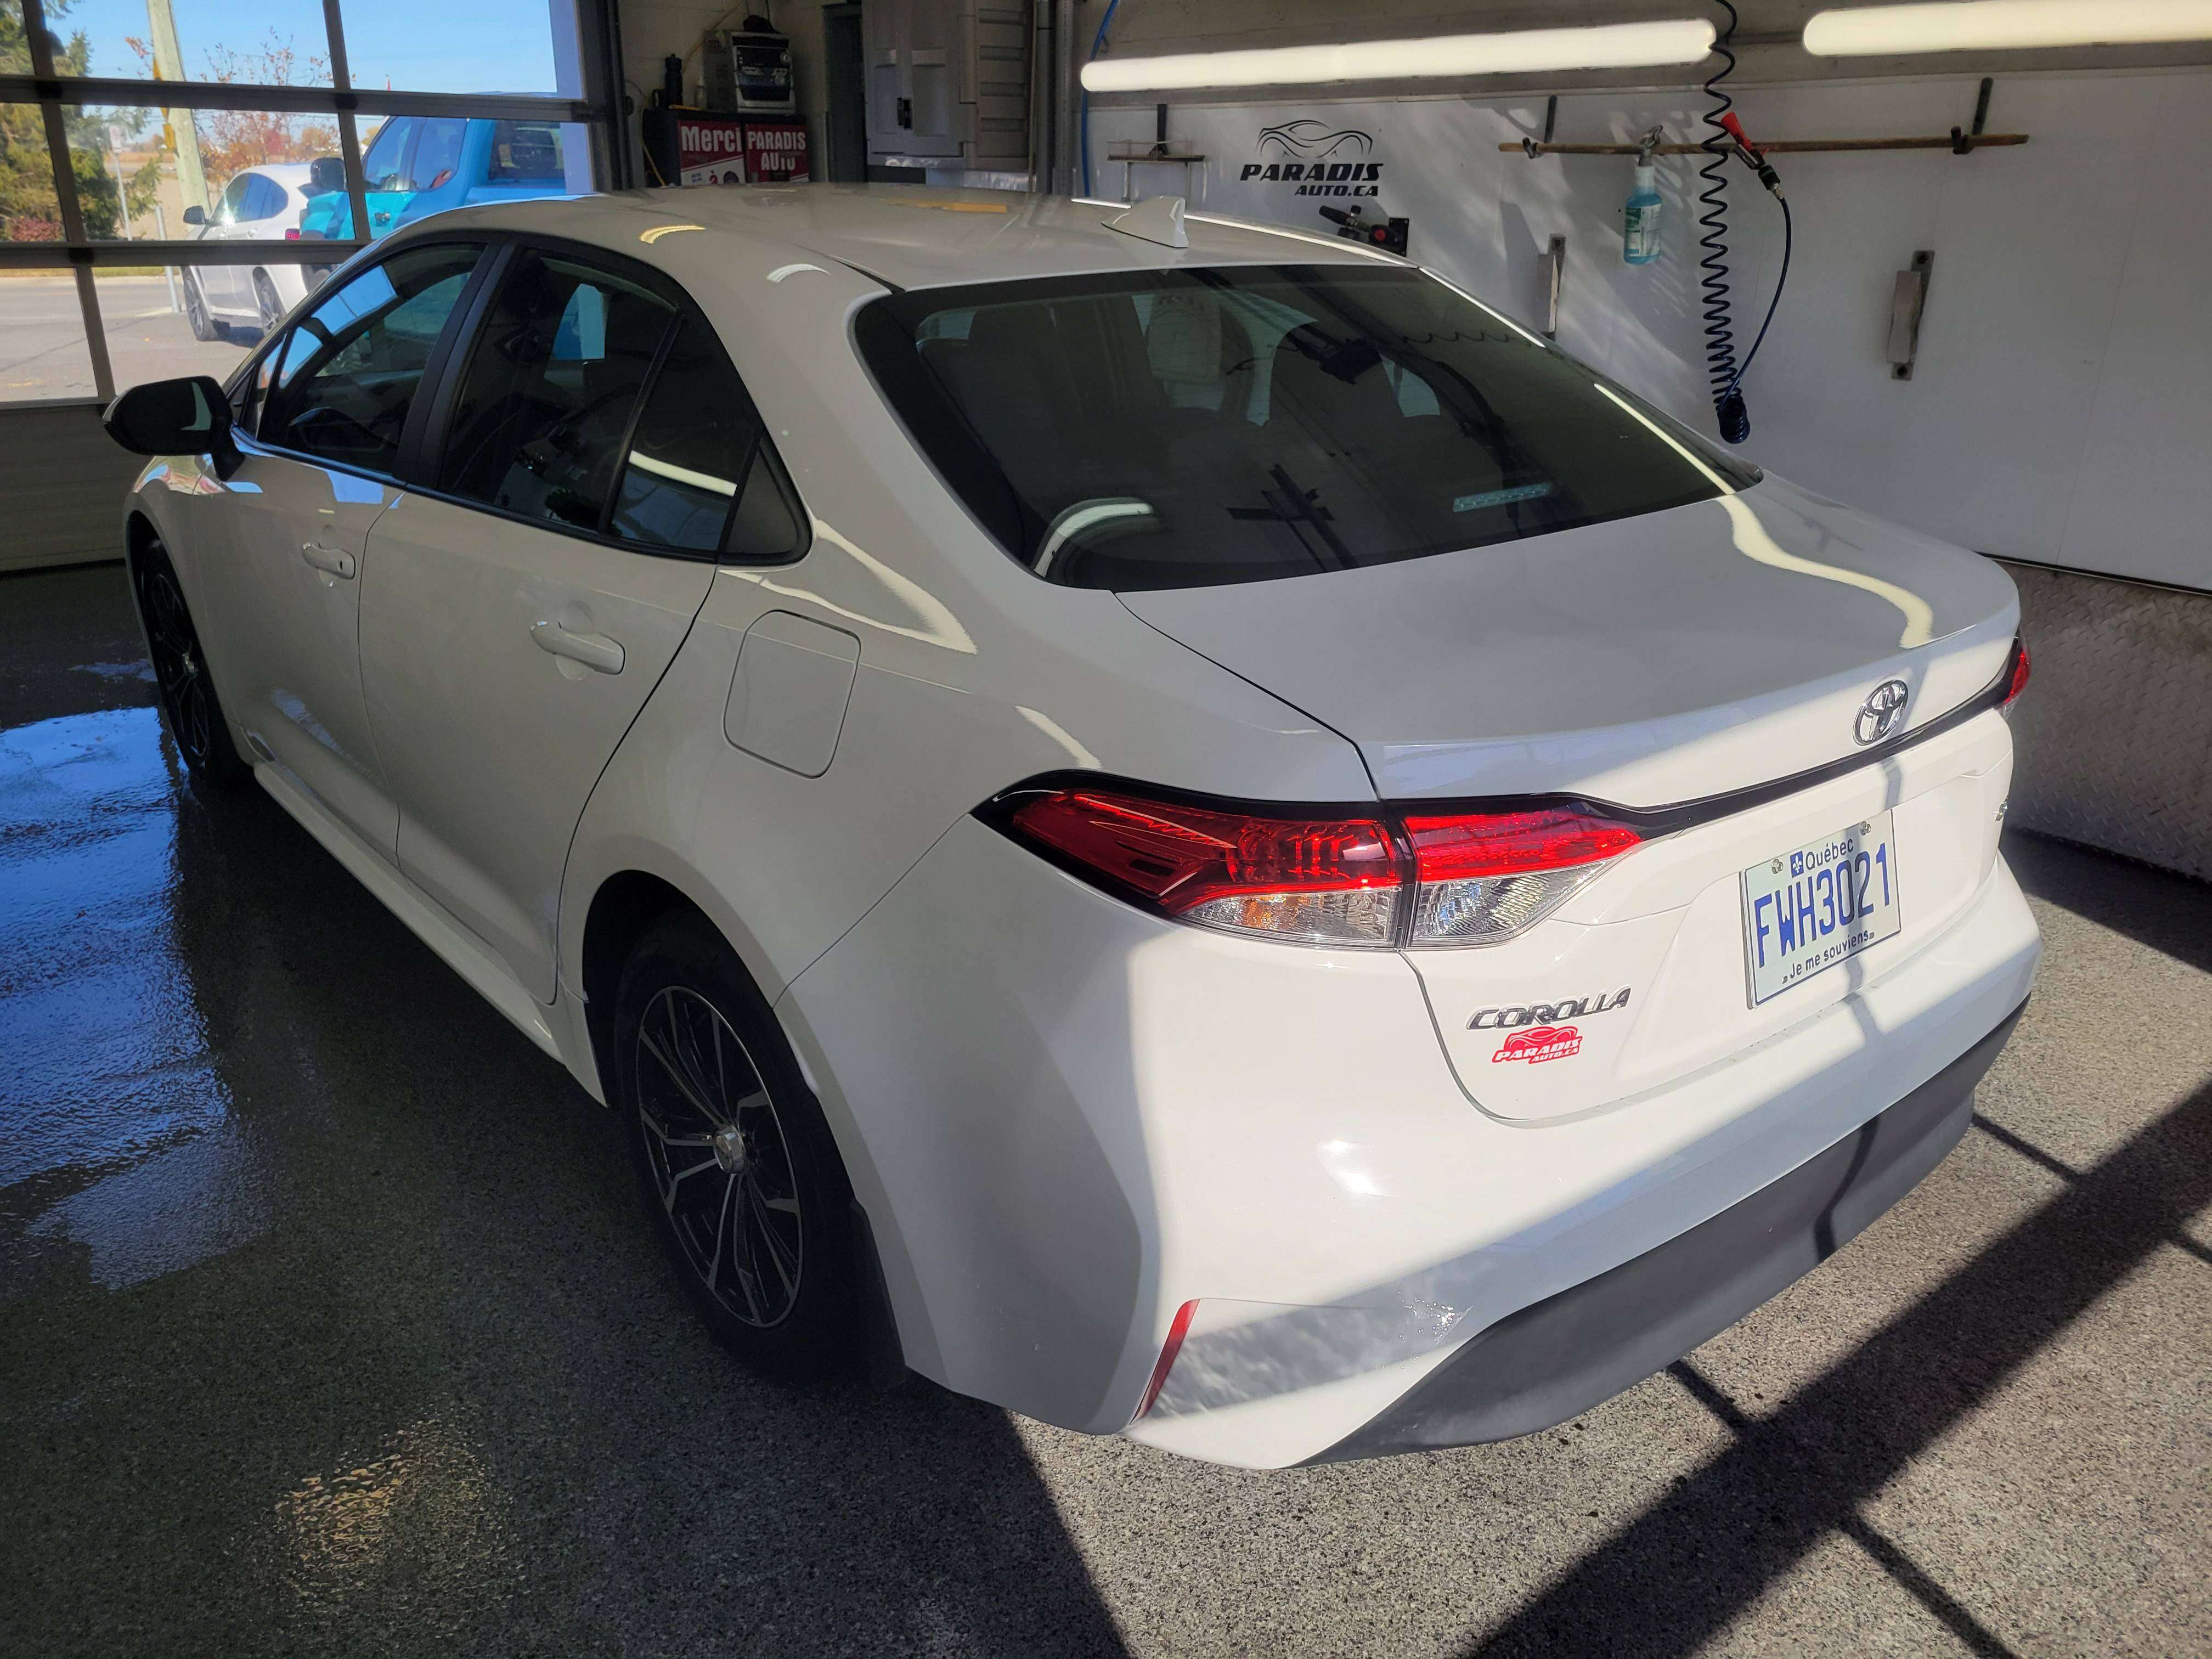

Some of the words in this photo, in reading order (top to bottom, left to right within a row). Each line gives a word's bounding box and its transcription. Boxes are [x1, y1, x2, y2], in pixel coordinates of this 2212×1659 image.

[681, 126, 742, 153] Merci
[748, 131, 806, 150] PARADIS
[1240, 163, 1384, 181] PARADIS
[1294, 185, 1378, 196] AUTO.CA
[1805, 838, 1854, 871] Québec
[1754, 843, 1890, 968] FWH3021
[1790, 963, 1802, 979] Je
[1805, 954, 1820, 971] me
[1824, 930, 1869, 961] souviens
[1466, 986, 1632, 1030] COROLLA
[1495, 1038, 1582, 1061] PARADIS
[1532, 1047, 1578, 1062] AUTO.CA
